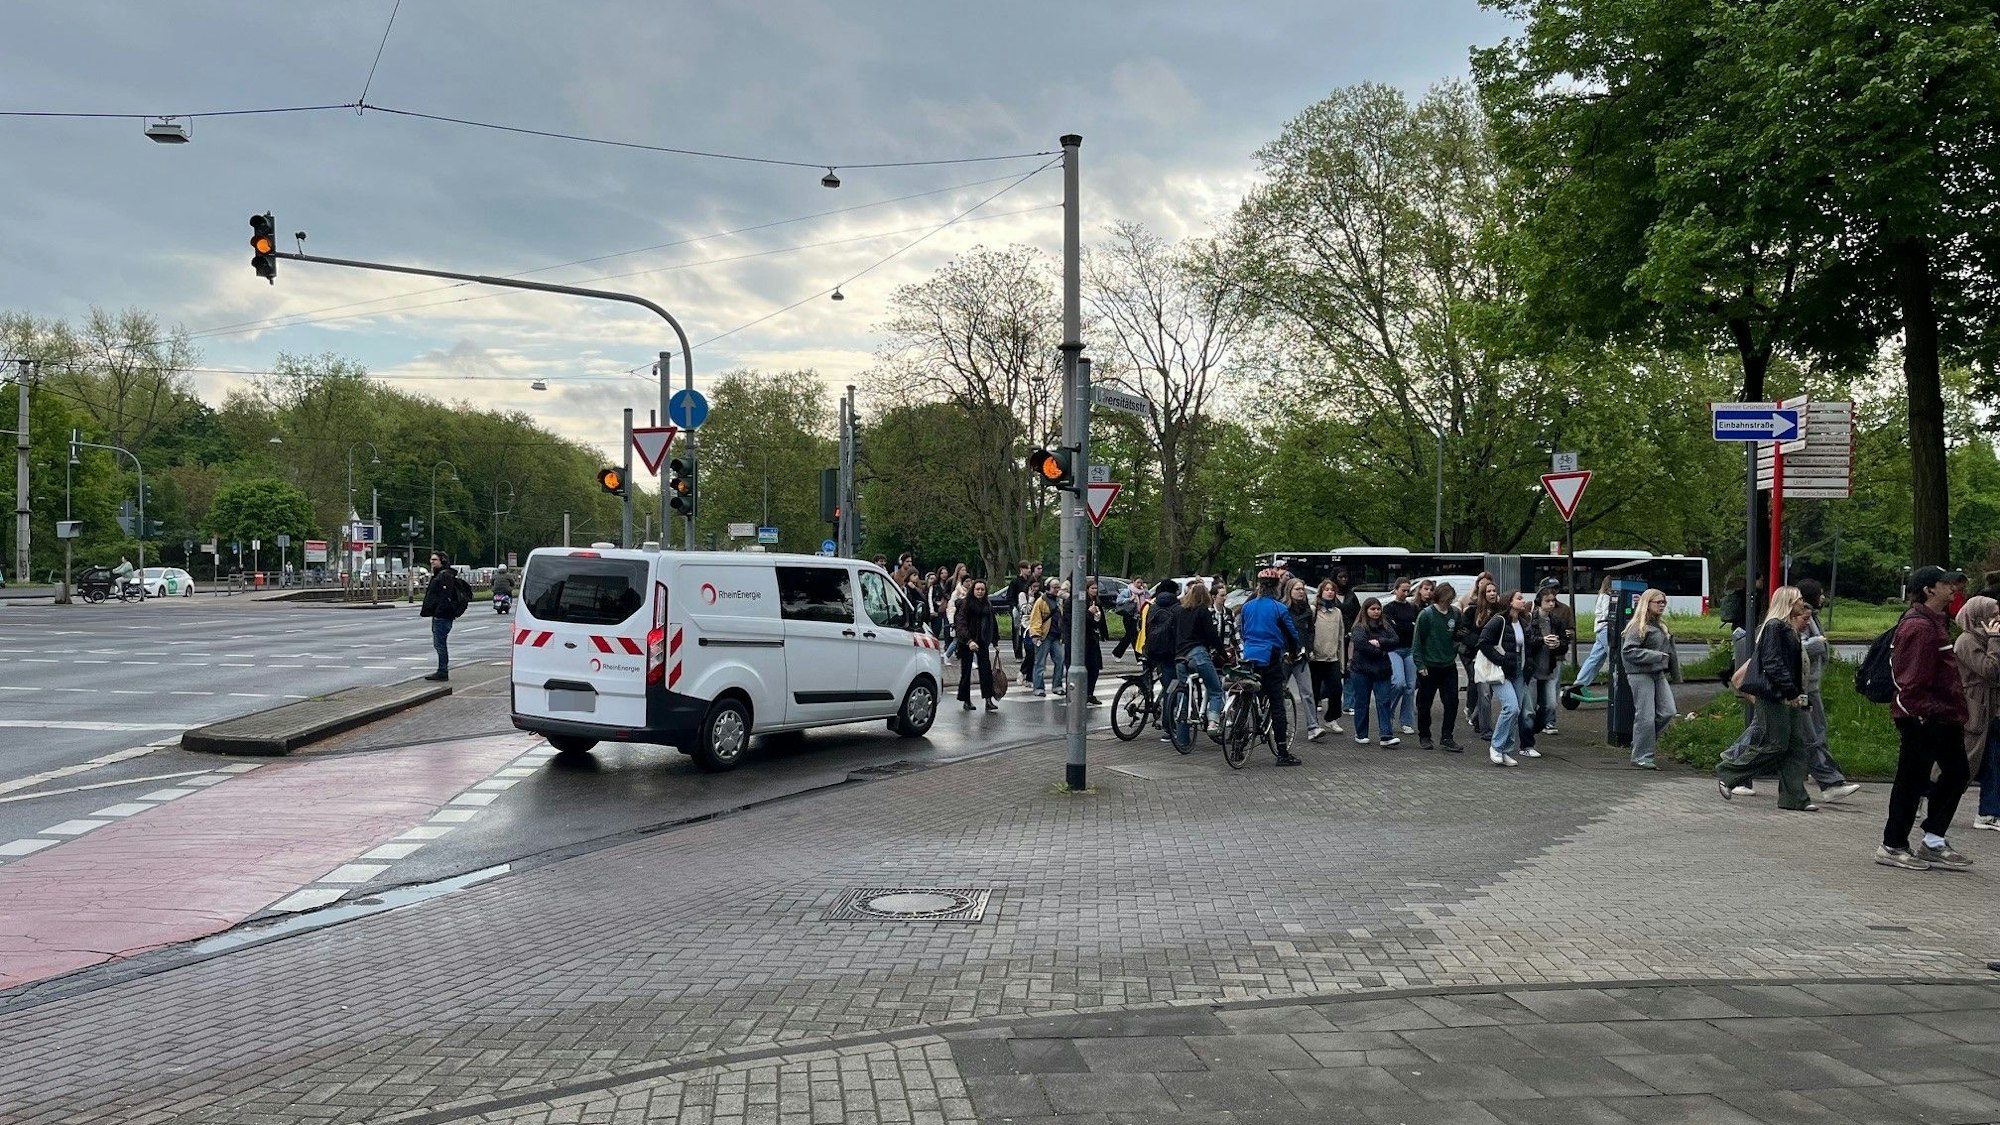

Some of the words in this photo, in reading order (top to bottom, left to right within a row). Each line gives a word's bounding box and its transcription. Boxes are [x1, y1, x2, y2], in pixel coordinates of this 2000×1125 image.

[1719, 421, 1775, 429] Einbahnstraße
[718, 590, 761, 600] RheinEnergie
[602, 664, 641, 672] RheinEnergie
